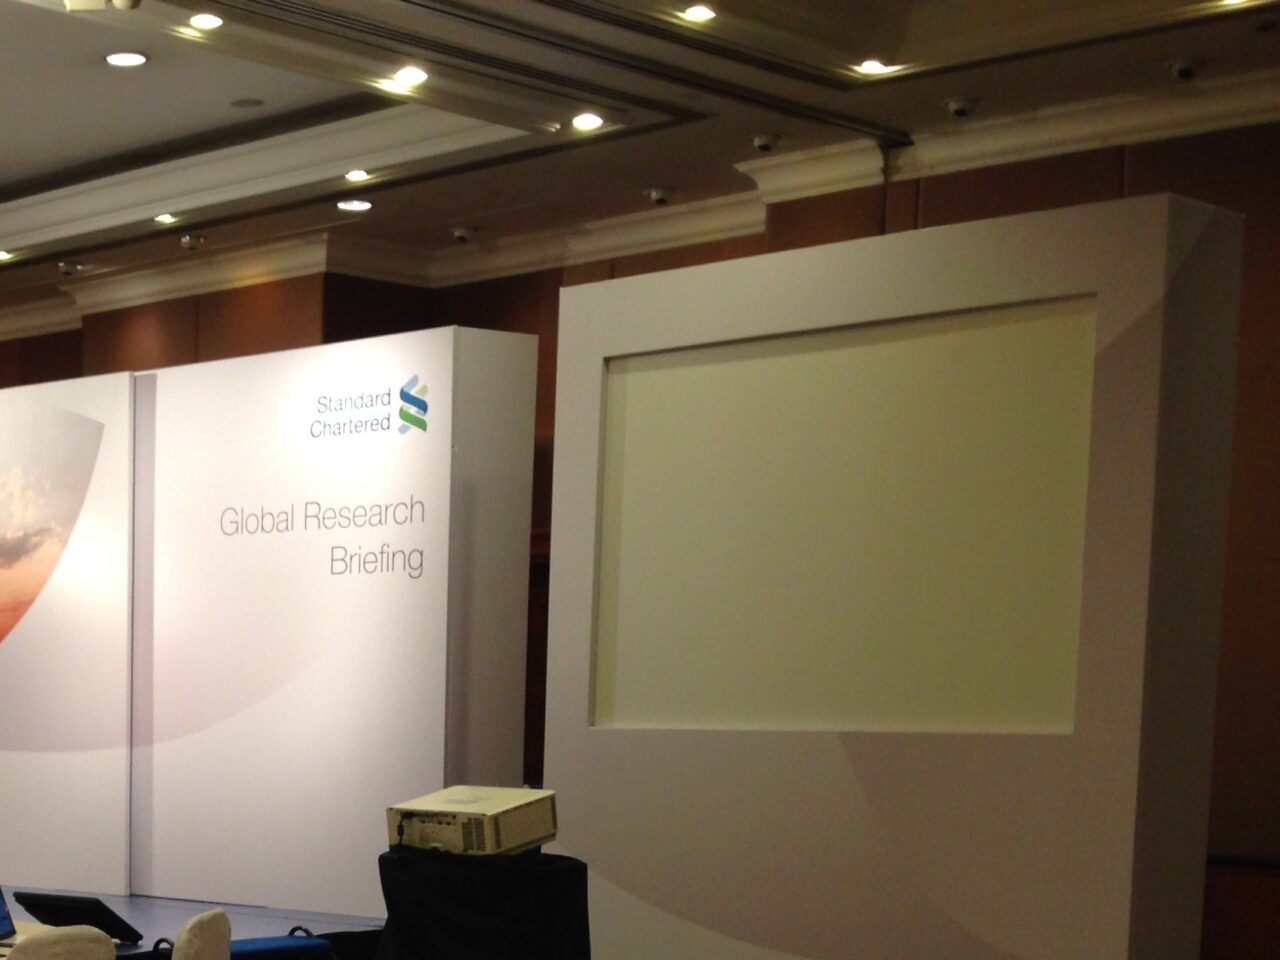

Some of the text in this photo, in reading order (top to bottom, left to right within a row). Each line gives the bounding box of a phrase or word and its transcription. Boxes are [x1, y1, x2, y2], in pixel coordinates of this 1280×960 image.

[317, 388, 391, 414] Standard
[310, 412, 391, 438] Chartered
[220, 494, 425, 536] Global Research
[330, 543, 424, 579] Briefing
